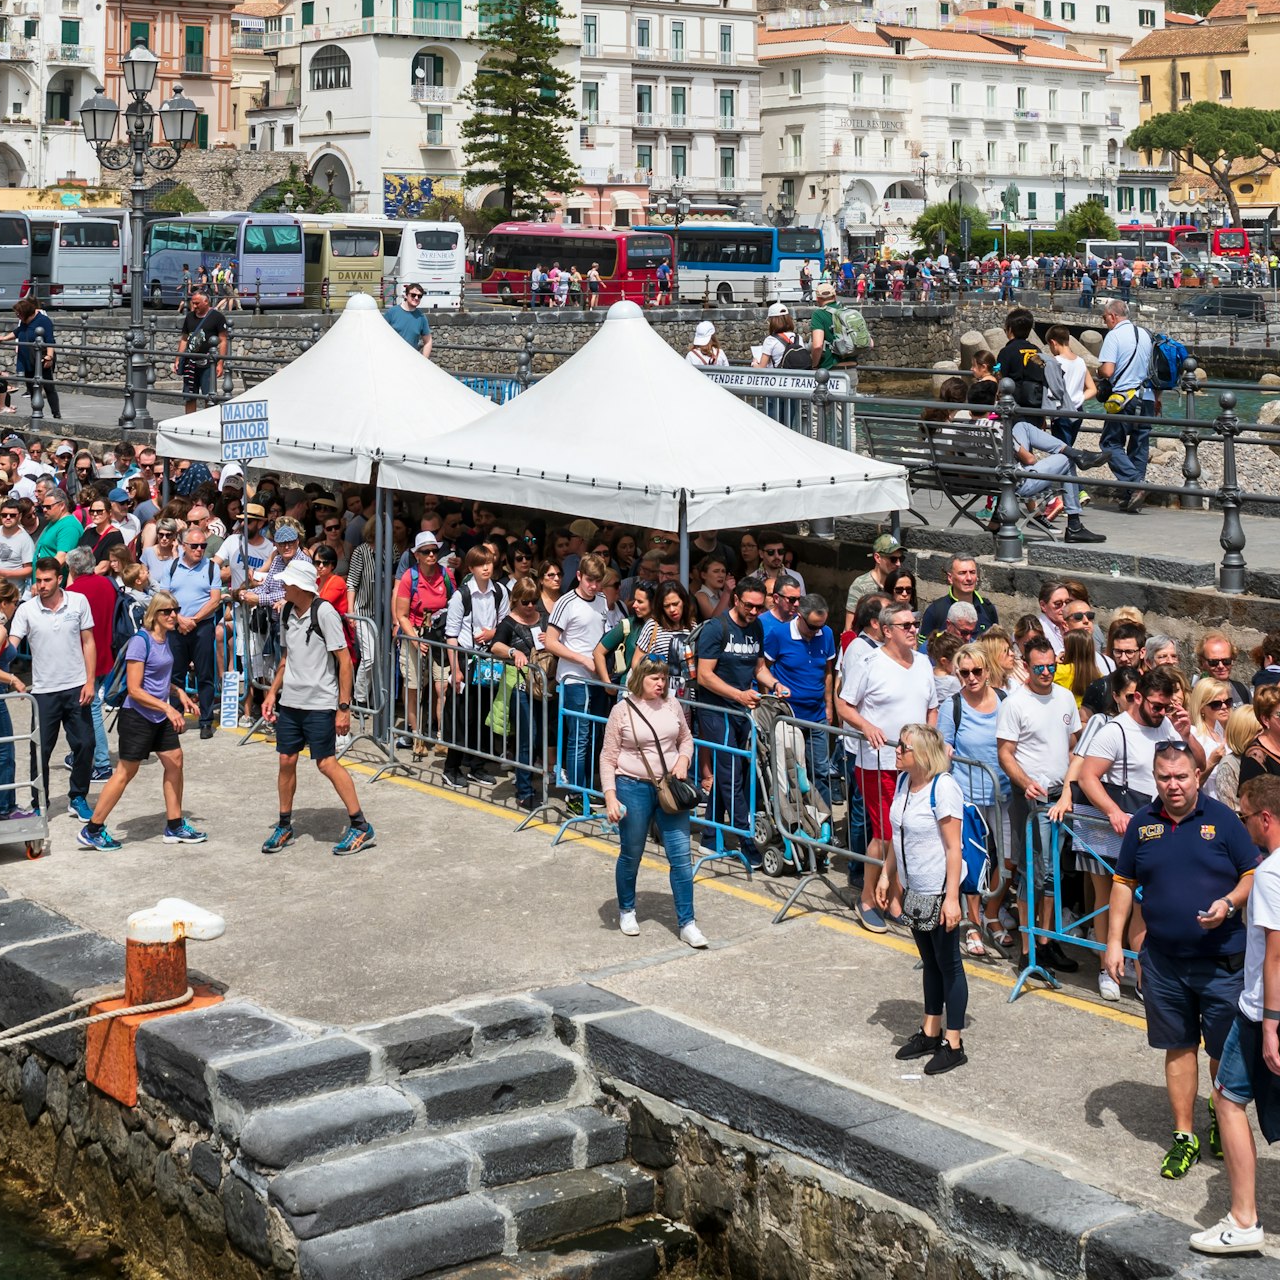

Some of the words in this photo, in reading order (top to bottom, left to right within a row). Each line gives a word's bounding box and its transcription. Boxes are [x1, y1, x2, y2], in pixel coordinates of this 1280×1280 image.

[840, 118, 864, 128] HOTEL
[866, 120, 904, 130] RESIDENCE
[338, 272, 373, 280] DAVANI
[707, 373, 745, 385] TTENDERE
[747, 375, 777, 387] DIETRO
[779, 377, 788, 387] LE
[791, 378, 840, 390] TRANSNE
[223, 403, 267, 420] MAIORI
[224, 422, 269, 439] MINORI
[223, 441, 267, 459] CETARA
[724, 634, 760, 654] diadora
[222, 673, 238, 728] SALERNO
[1138, 824, 1165, 839] FCB
